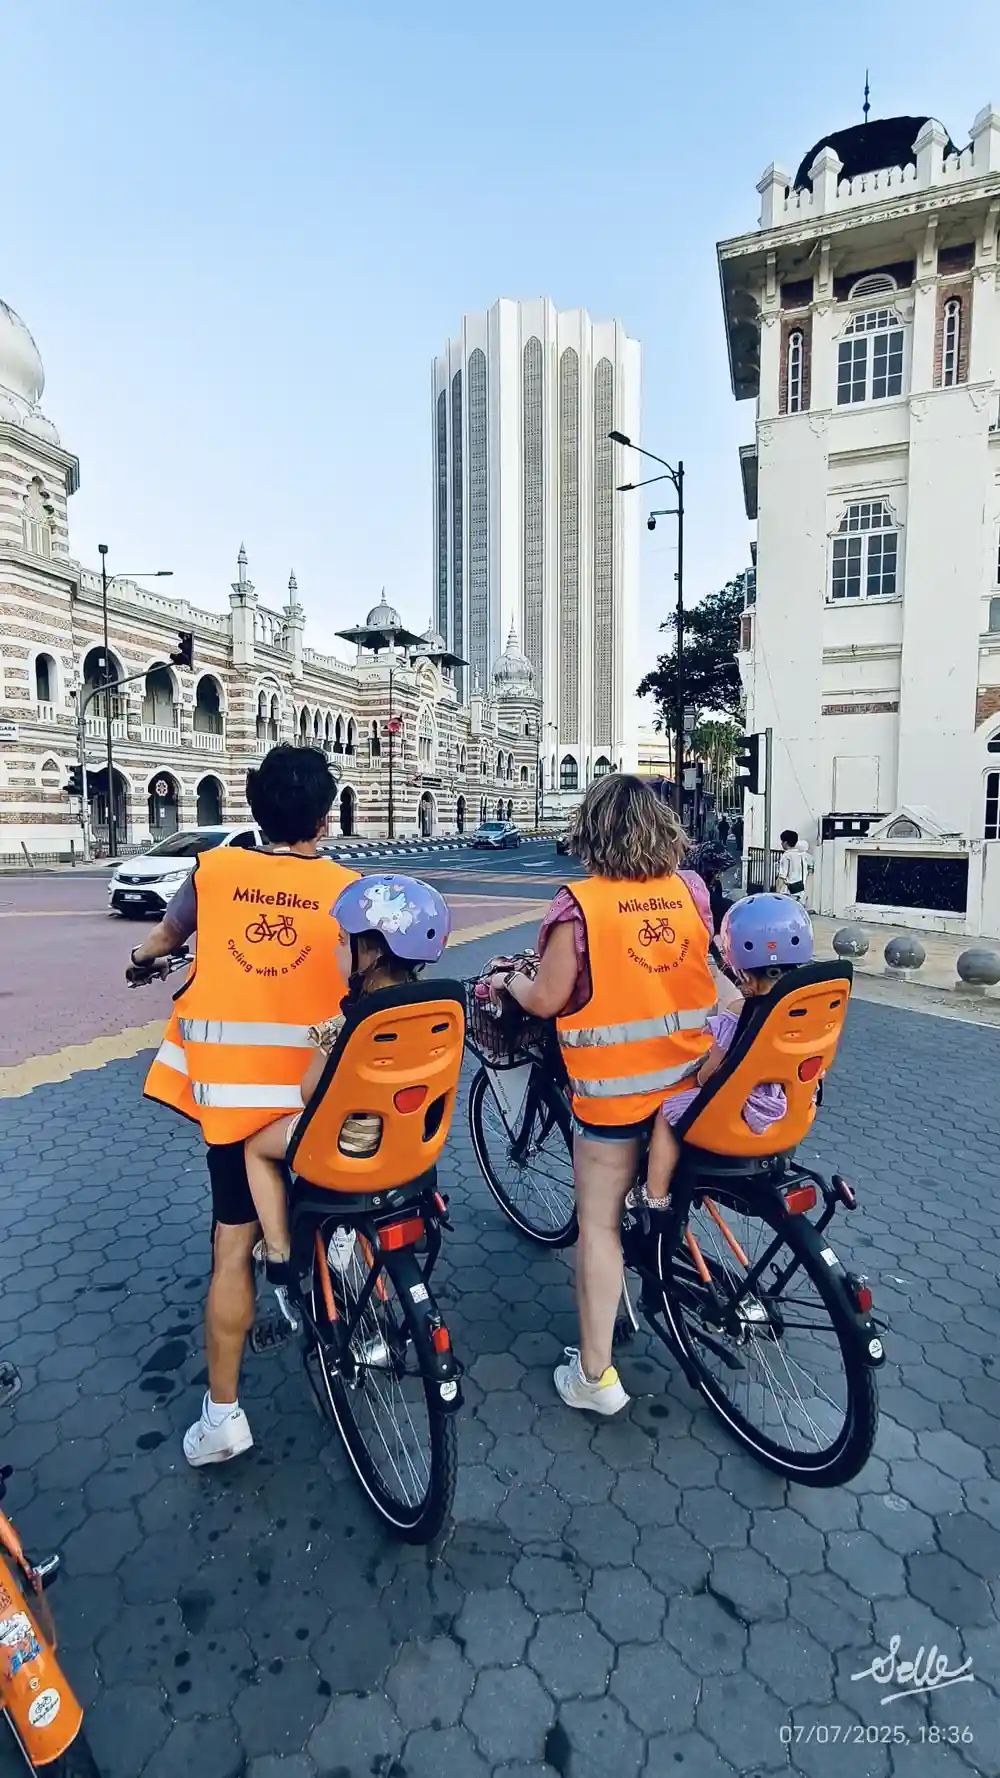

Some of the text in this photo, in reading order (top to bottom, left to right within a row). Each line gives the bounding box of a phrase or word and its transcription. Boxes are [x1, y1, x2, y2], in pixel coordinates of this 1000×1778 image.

[232, 886, 320, 910] MikeBikes
[618, 897, 683, 913] MikeBikes
[227, 938, 312, 977] cycling with a smile
[627, 947, 652, 973] cycling
[653, 963, 670, 973] with
[679, 938, 690, 963] smile
